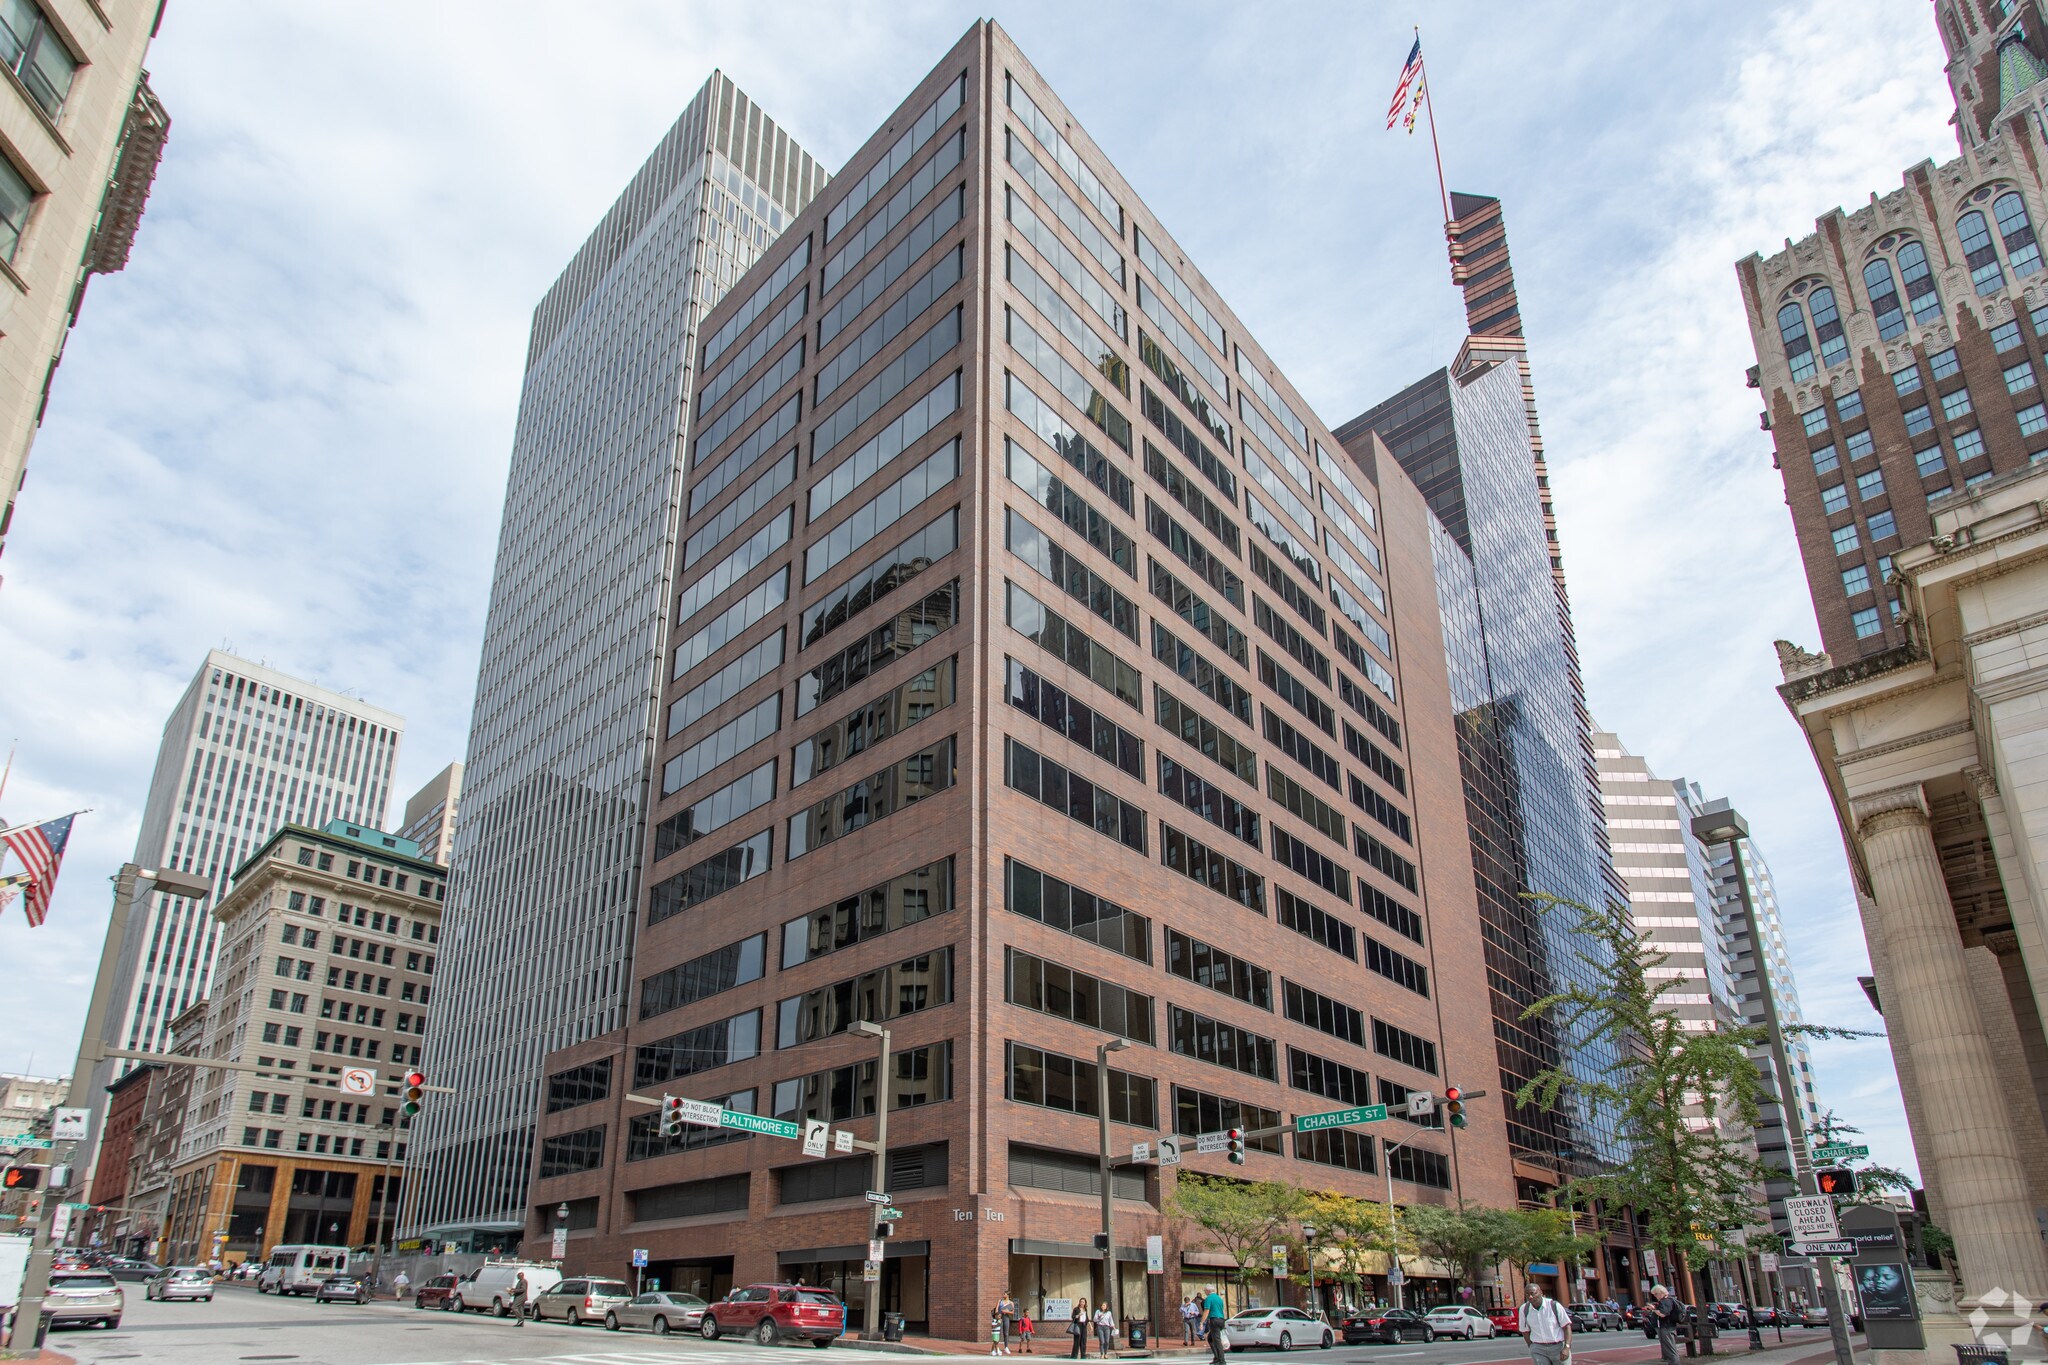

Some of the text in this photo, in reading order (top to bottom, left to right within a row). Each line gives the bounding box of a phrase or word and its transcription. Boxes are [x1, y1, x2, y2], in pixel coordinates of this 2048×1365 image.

[703, 1105, 720, 1114] BLOCK
[682, 1111, 719, 1123] INTERSECTION
[1304, 1109, 1382, 1128] CHARLES ST.
[722, 1113, 797, 1136] BALTIMORE ST.
[1217, 1133, 1229, 1141] BLO
[807, 1141, 824, 1150] ONLY
[1200, 1141, 1229, 1152] INTERSECTI
[1822, 1148, 1858, 1159] CHARLES
[1161, 1155, 1178, 1165] ONLY
[1788, 1199, 1828, 1209] SIDEWALK
[953, 1208, 973, 1221] Ten
[984, 1207, 1004, 1221] Ten
[1794, 1207, 1826, 1217] CLOSED
[1799, 1216, 1826, 1224] AHEAD
[1816, 1222, 1834, 1230] HERE
[1805, 1243, 1848, 1251] ONE WAY
